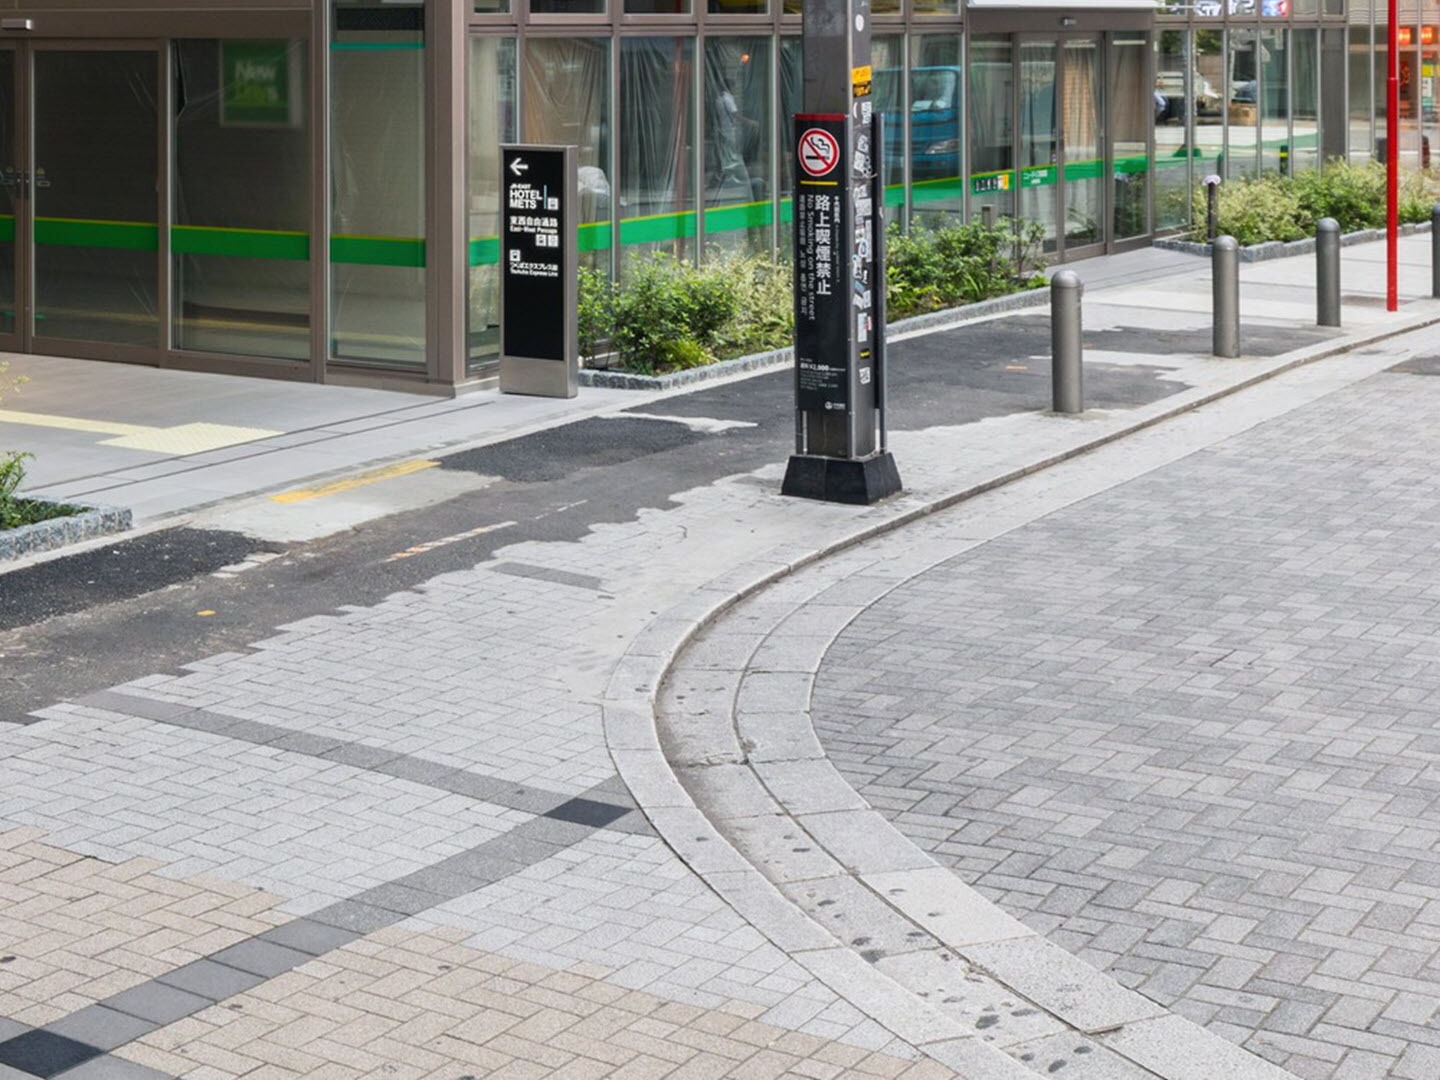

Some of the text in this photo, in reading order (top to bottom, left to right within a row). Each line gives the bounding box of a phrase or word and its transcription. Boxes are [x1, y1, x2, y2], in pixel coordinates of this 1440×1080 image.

[509, 189, 543, 200] HOTEL
[509, 199, 536, 209] METS
[806, 194, 816, 321] No Smoking on the street
[814, 194, 832, 295] 路上喫煙禁止
